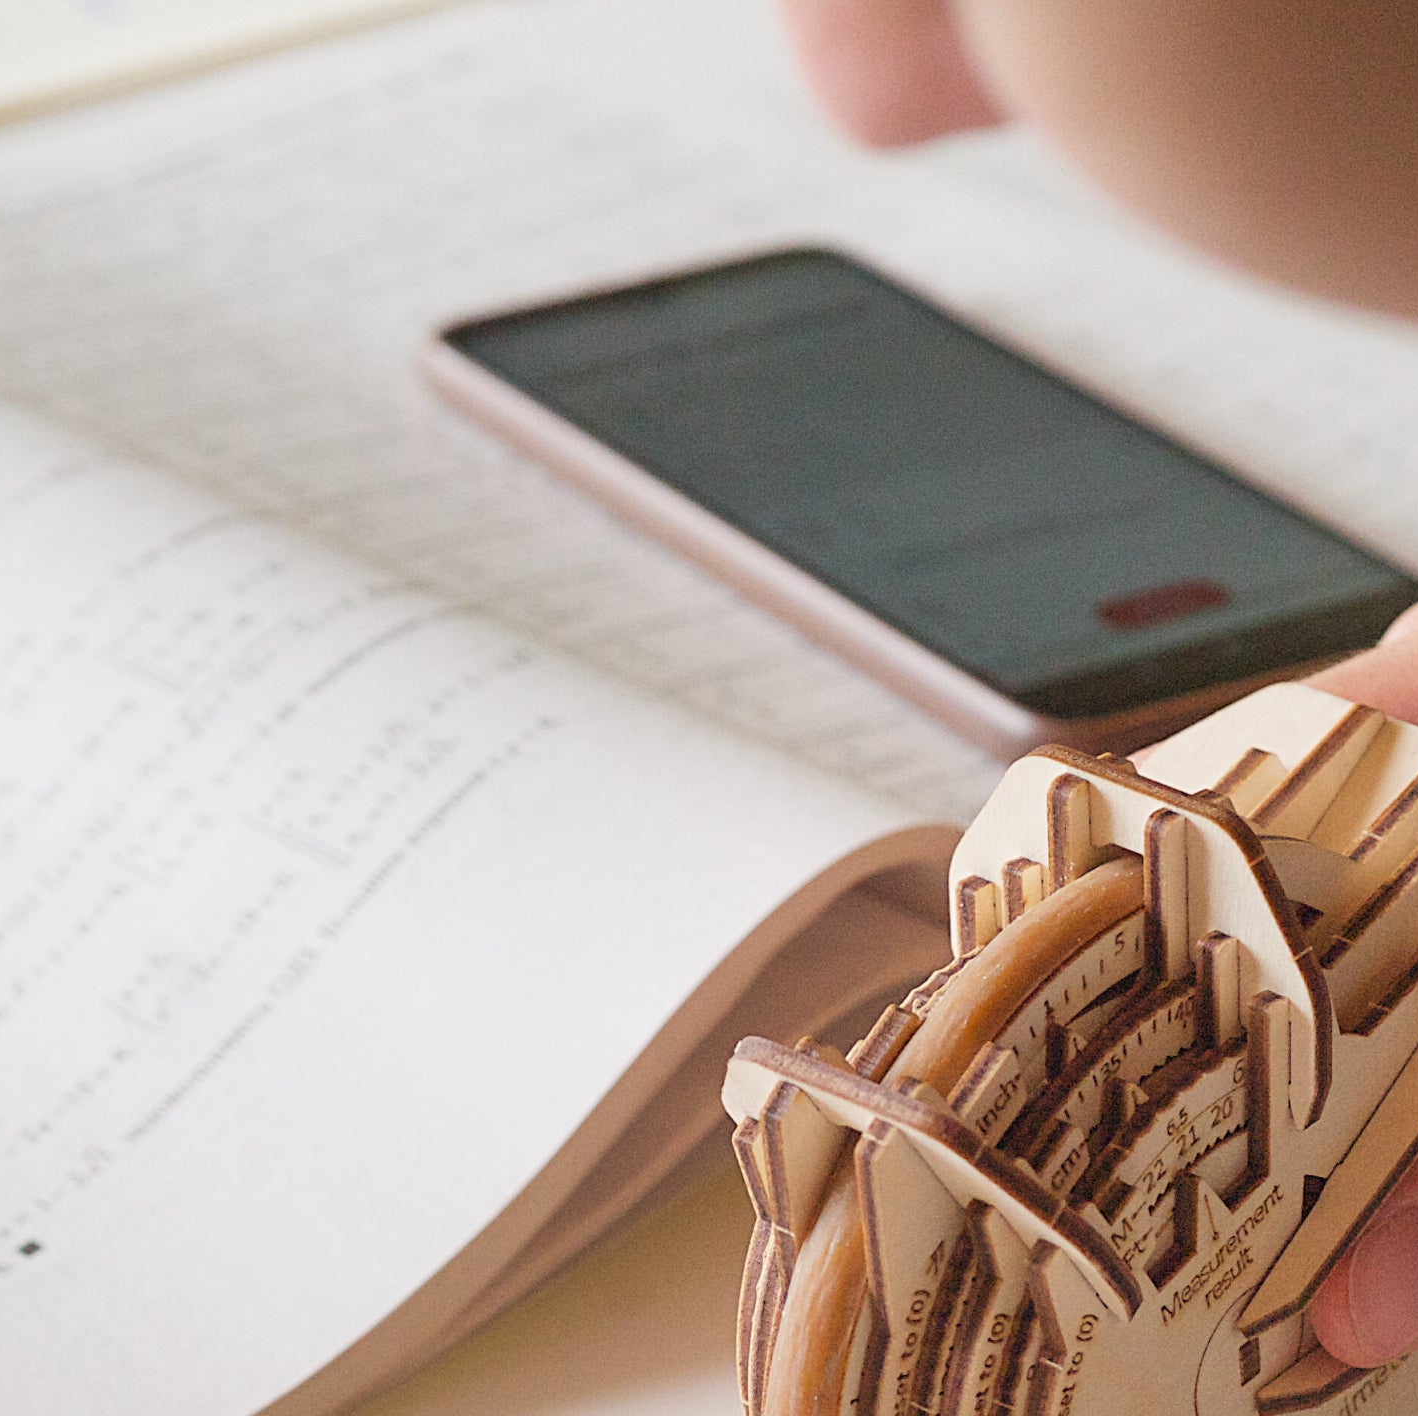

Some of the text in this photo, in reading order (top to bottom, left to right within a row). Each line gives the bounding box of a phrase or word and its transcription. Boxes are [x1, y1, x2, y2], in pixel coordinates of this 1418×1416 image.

[1142, 1095, 1233, 1194] 22 21 20
[1051, 1148, 1081, 1191] cm
[1110, 1217, 1134, 1251] M
[1160, 1183, 1285, 1328] Measurement
[1204, 1245, 1254, 1310] result
[900, 1331, 918, 1360] to
[1066, 1351, 1084, 1377] to
[979, 1353, 996, 1381] to
